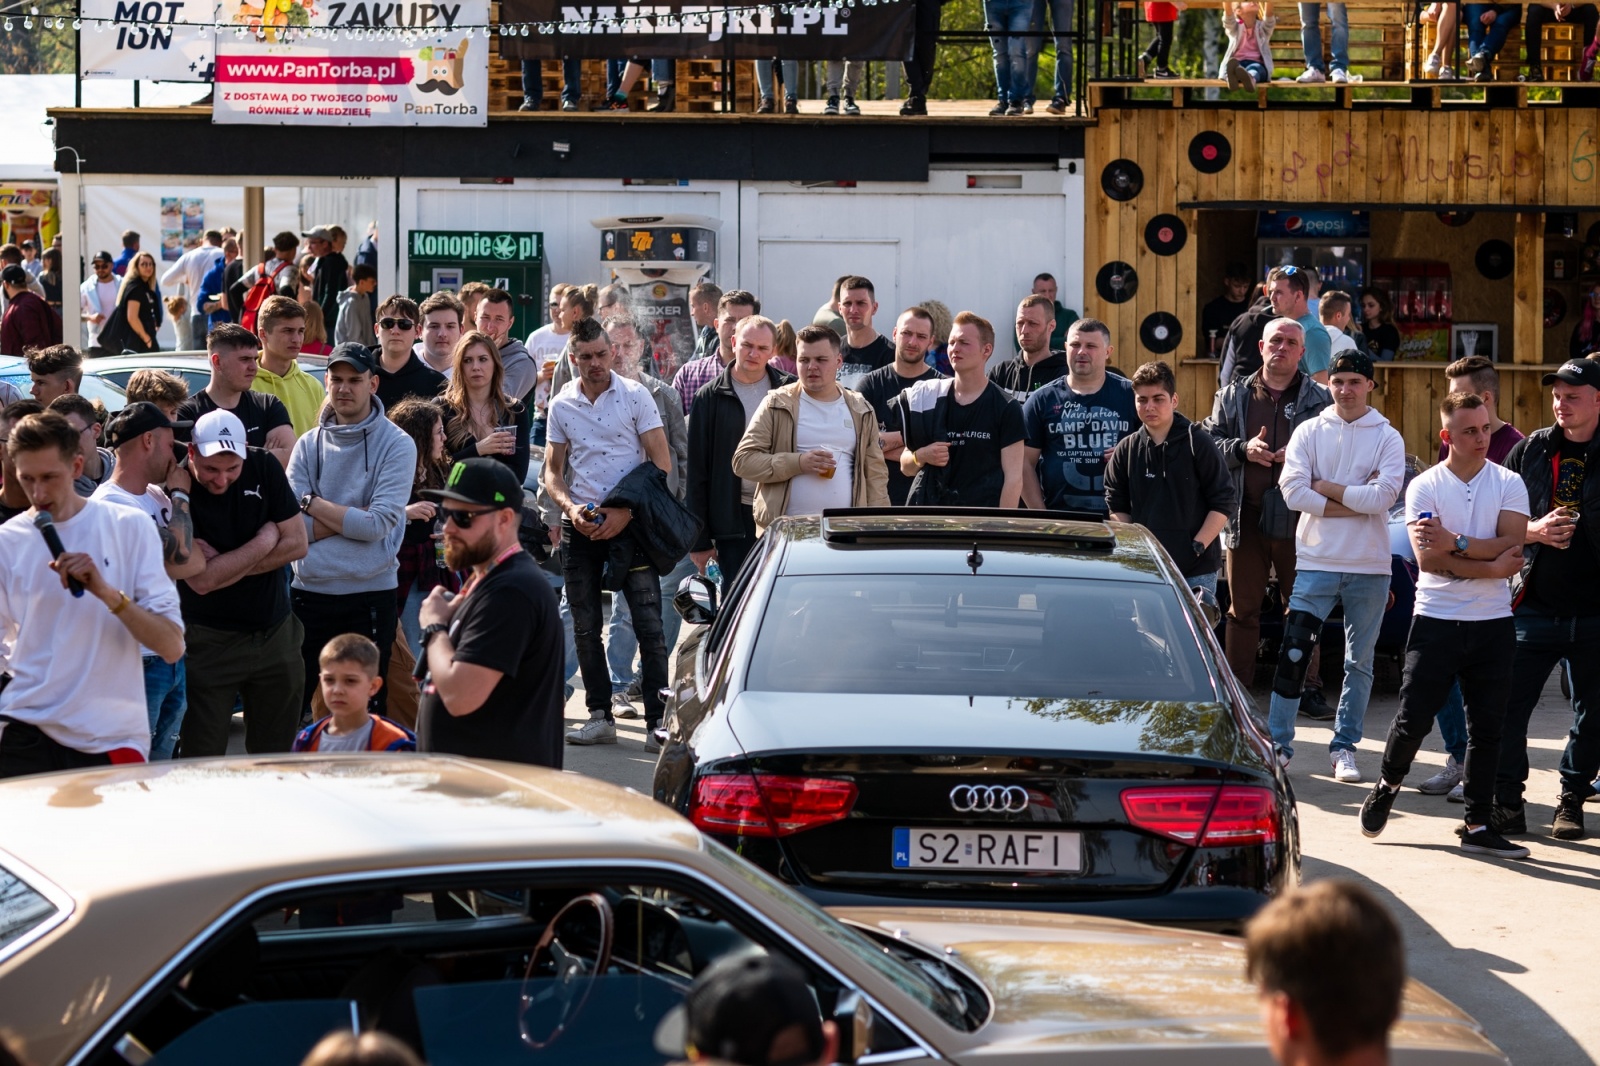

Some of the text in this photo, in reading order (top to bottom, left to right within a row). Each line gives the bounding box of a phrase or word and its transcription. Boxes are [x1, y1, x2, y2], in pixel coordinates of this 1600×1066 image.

[115, 1, 184, 23] MOT
[328, 2, 461, 32] ZAKUPY
[116, 27, 173, 50] ION
[227, 62, 396, 81] www.PanTorba.pl
[224, 93, 398, 103] Z DOSTAWĄ DO TWOJEGO DOMU
[249, 105, 371, 117] RÓWNIEŻ W NIEDZIELĘ
[404, 103, 478, 115] PanTorba
[1306, 218, 1344, 232] pepsi
[413, 232, 492, 259] Konopie
[637, 306, 681, 315] BOXER
[1061, 406, 1120, 424] Navigation
[1048, 420, 1129, 434] CAMP DAVID
[1063, 433, 1112, 449] BLUE
[896, 852, 907, 861] PL
[919, 833, 1059, 866] S2 RAFI
